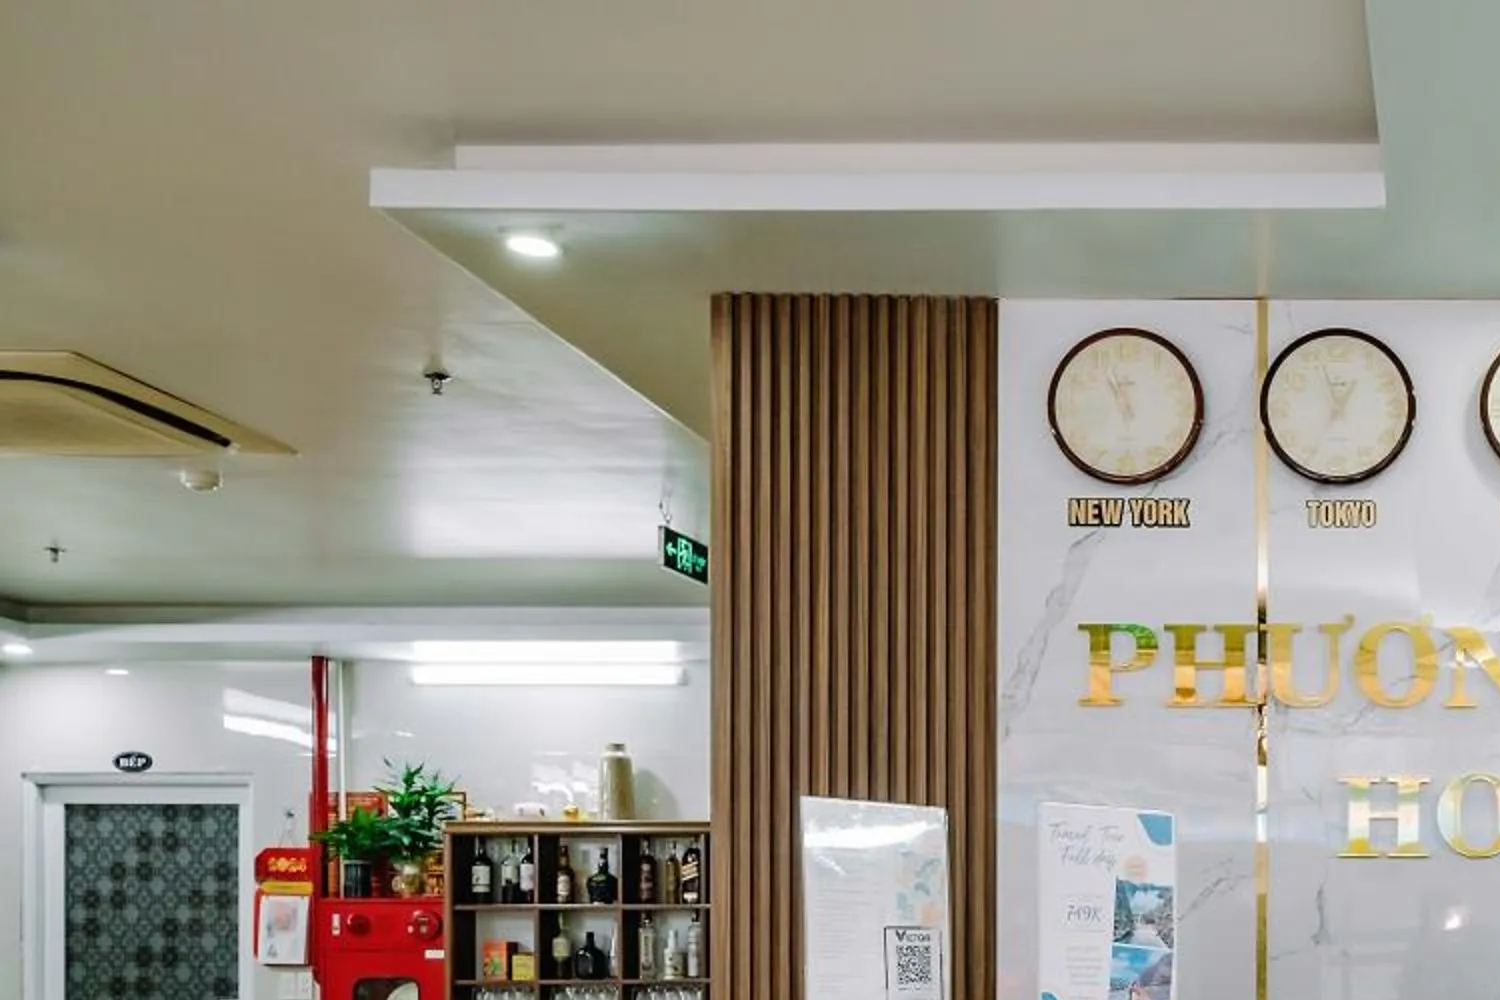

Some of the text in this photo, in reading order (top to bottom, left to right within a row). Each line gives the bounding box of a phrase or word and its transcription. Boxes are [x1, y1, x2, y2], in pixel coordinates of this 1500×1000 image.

[1068, 498, 1190, 527] NEW YORK
[1307, 500, 1376, 528] TOKYO
